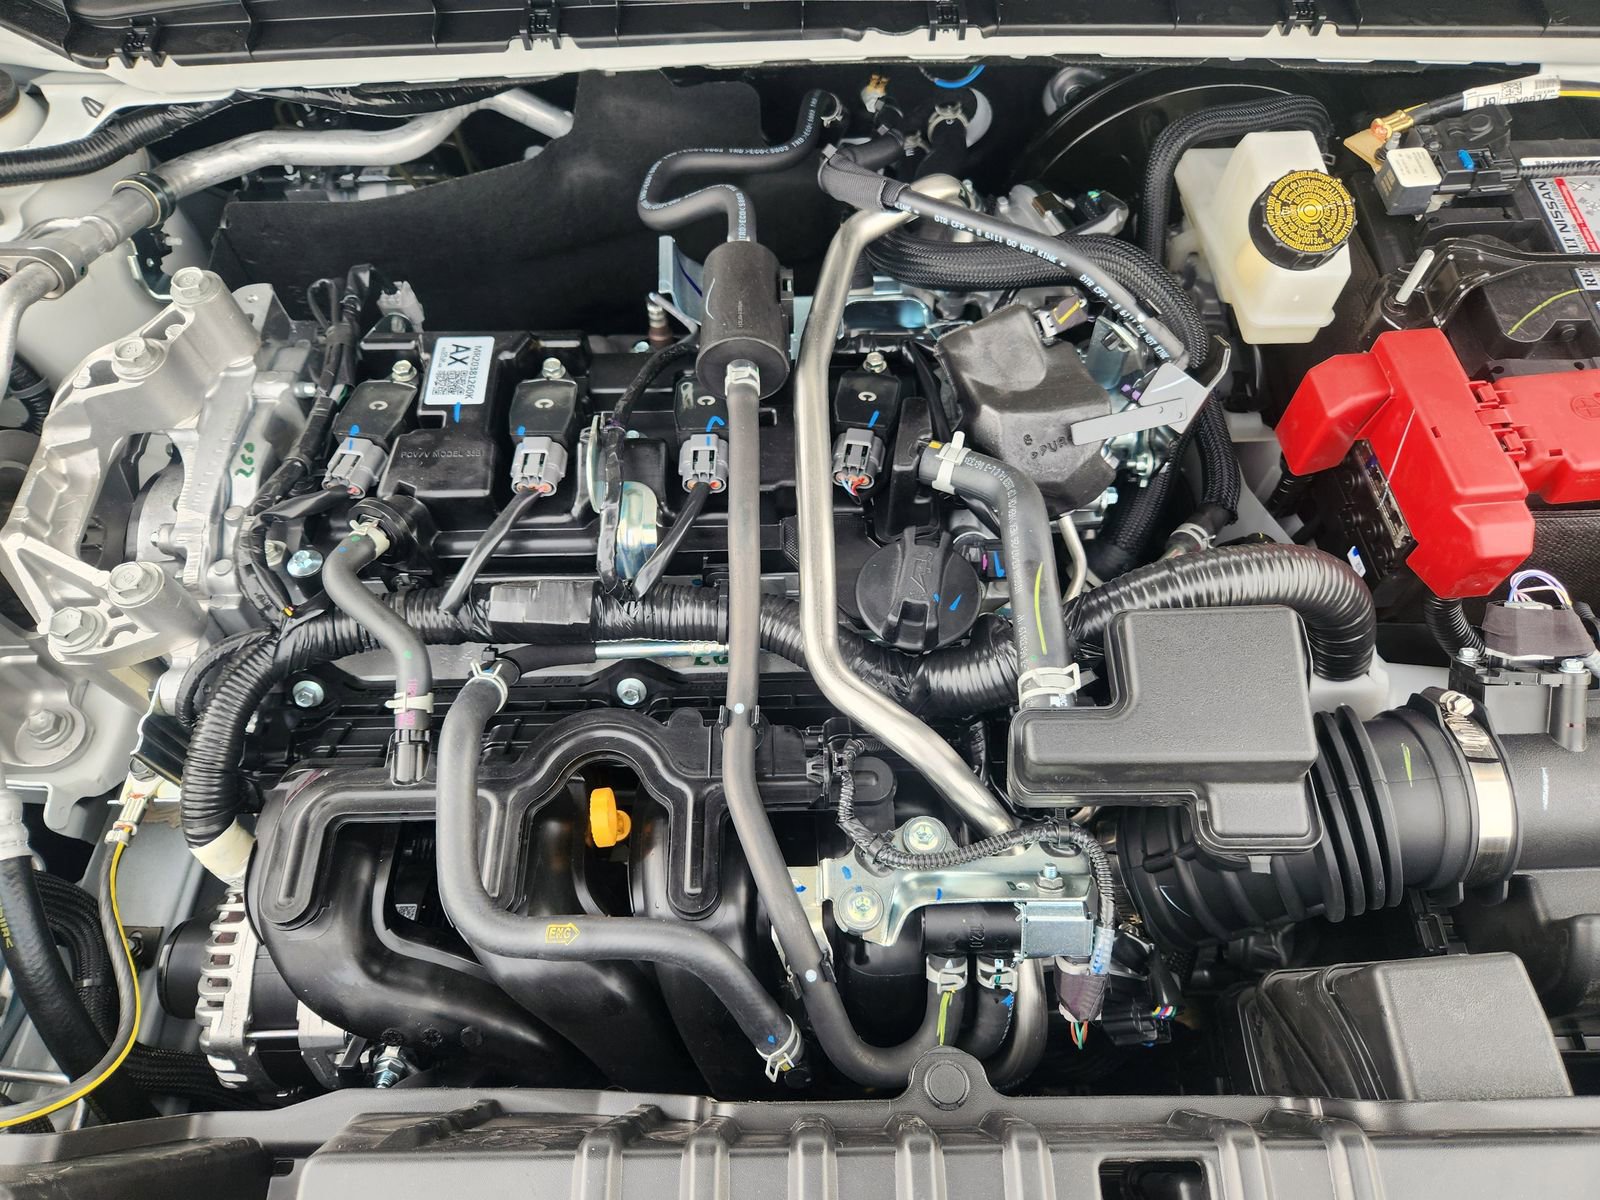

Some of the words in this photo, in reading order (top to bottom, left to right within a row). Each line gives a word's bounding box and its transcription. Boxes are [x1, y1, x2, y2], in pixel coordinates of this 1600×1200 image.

[1536, 181, 1571, 233] NISSAN
[447, 343, 472, 366] AX
[548, 926, 571, 939] ENG
